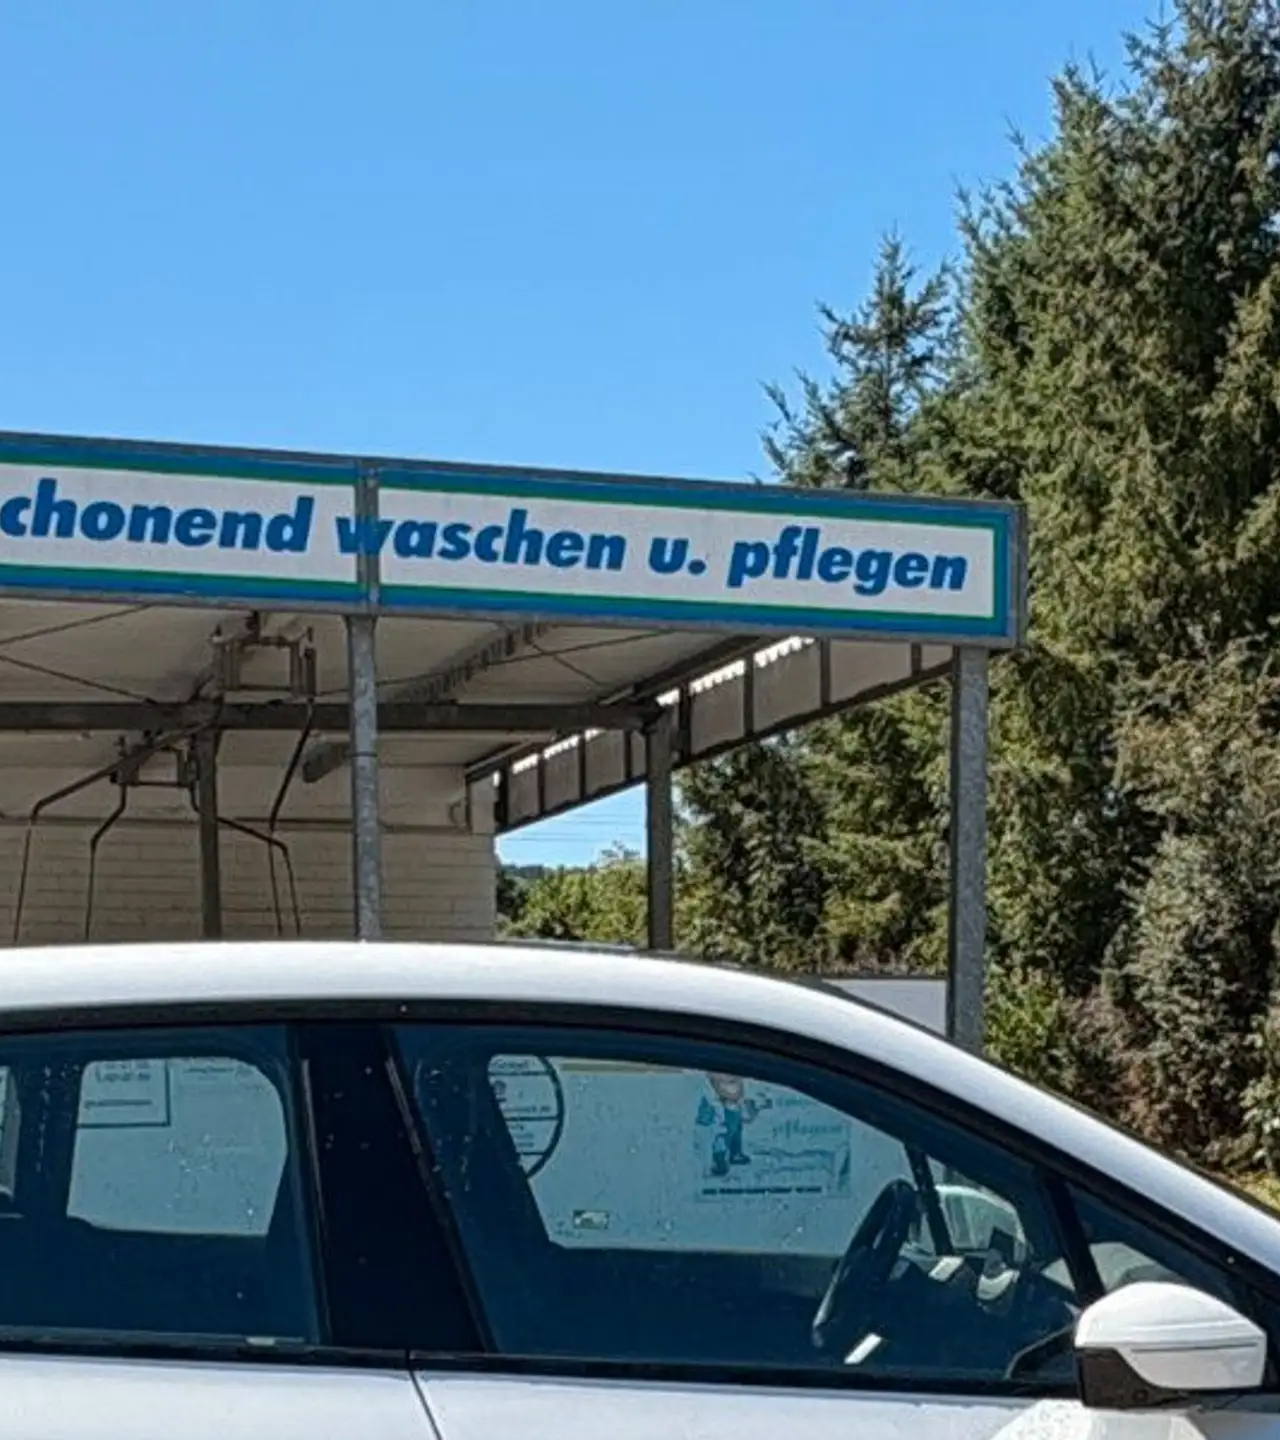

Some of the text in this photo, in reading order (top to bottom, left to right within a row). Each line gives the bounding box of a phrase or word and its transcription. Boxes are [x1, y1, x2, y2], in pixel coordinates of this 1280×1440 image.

[334, 507, 627, 570] waschen
[647, 536, 707, 576] u.
[726, 525, 969, 597] pflegen
